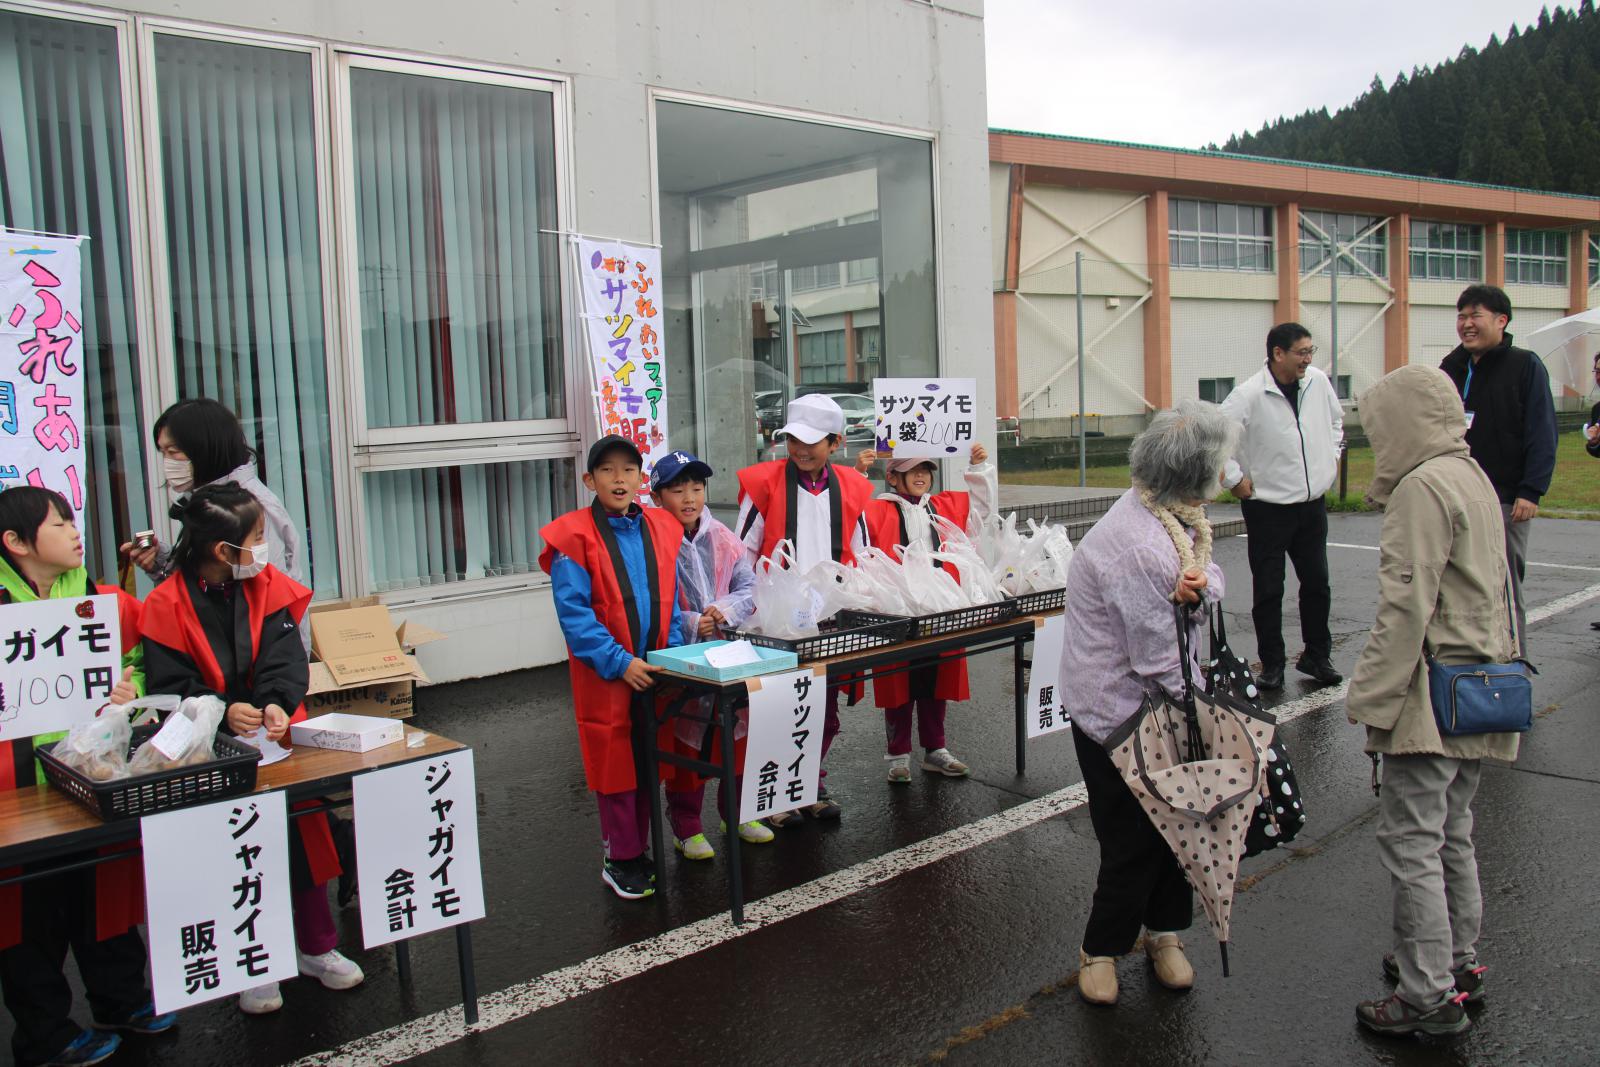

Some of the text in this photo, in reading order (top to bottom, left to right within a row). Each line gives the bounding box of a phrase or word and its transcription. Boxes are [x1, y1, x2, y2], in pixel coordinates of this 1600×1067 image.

[880, 394, 972, 415] サツマイモ
[5, 622, 111, 664] ガイモ
[0, 666, 113, 711] 100円
[1039, 685, 1053, 729] 販売
[785, 676, 812, 803] サツマイモ
[757, 760, 779, 812] 会計
[425, 761, 461, 918] ジャガイモ
[228, 802, 269, 977] ジャガイモ
[385, 868, 418, 932] 会計
[181, 919, 220, 995] 販売
